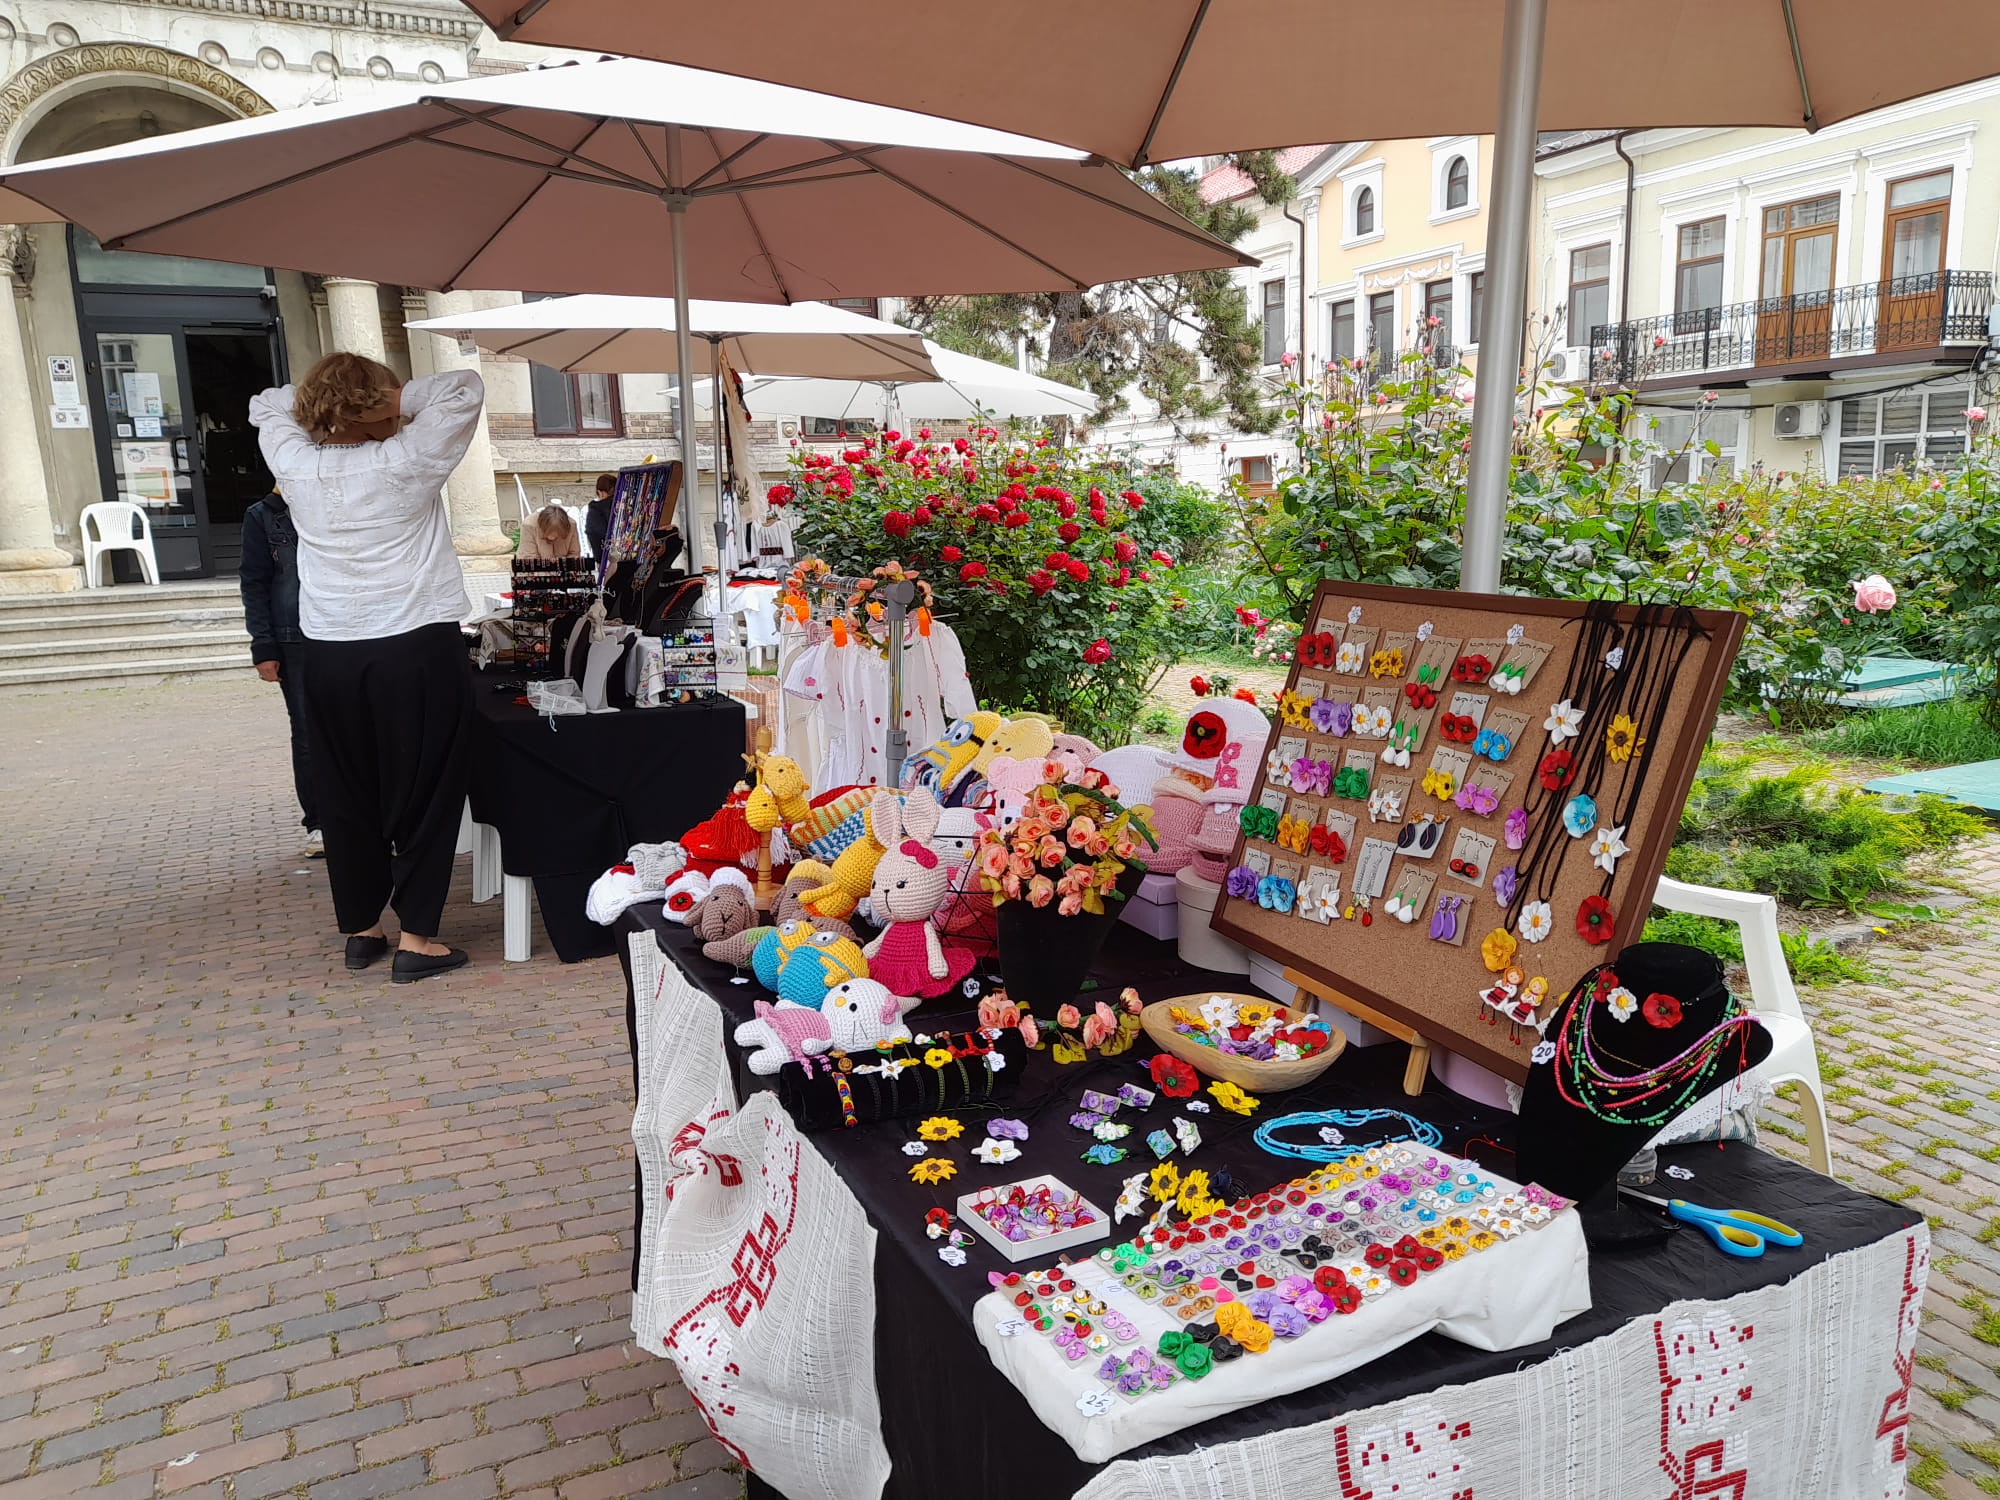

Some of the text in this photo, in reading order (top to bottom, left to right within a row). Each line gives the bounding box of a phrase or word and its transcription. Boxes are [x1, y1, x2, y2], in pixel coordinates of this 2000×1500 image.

[1608, 653, 1621, 664] 25
[965, 982, 979, 995] 130
[1535, 1047, 1552, 1058] 20
[910, 1144, 924, 1155] 25
[1105, 1283, 1121, 1293] 10
[1002, 1319, 1024, 1330] 15
[1085, 1393, 1109, 1408] 25
